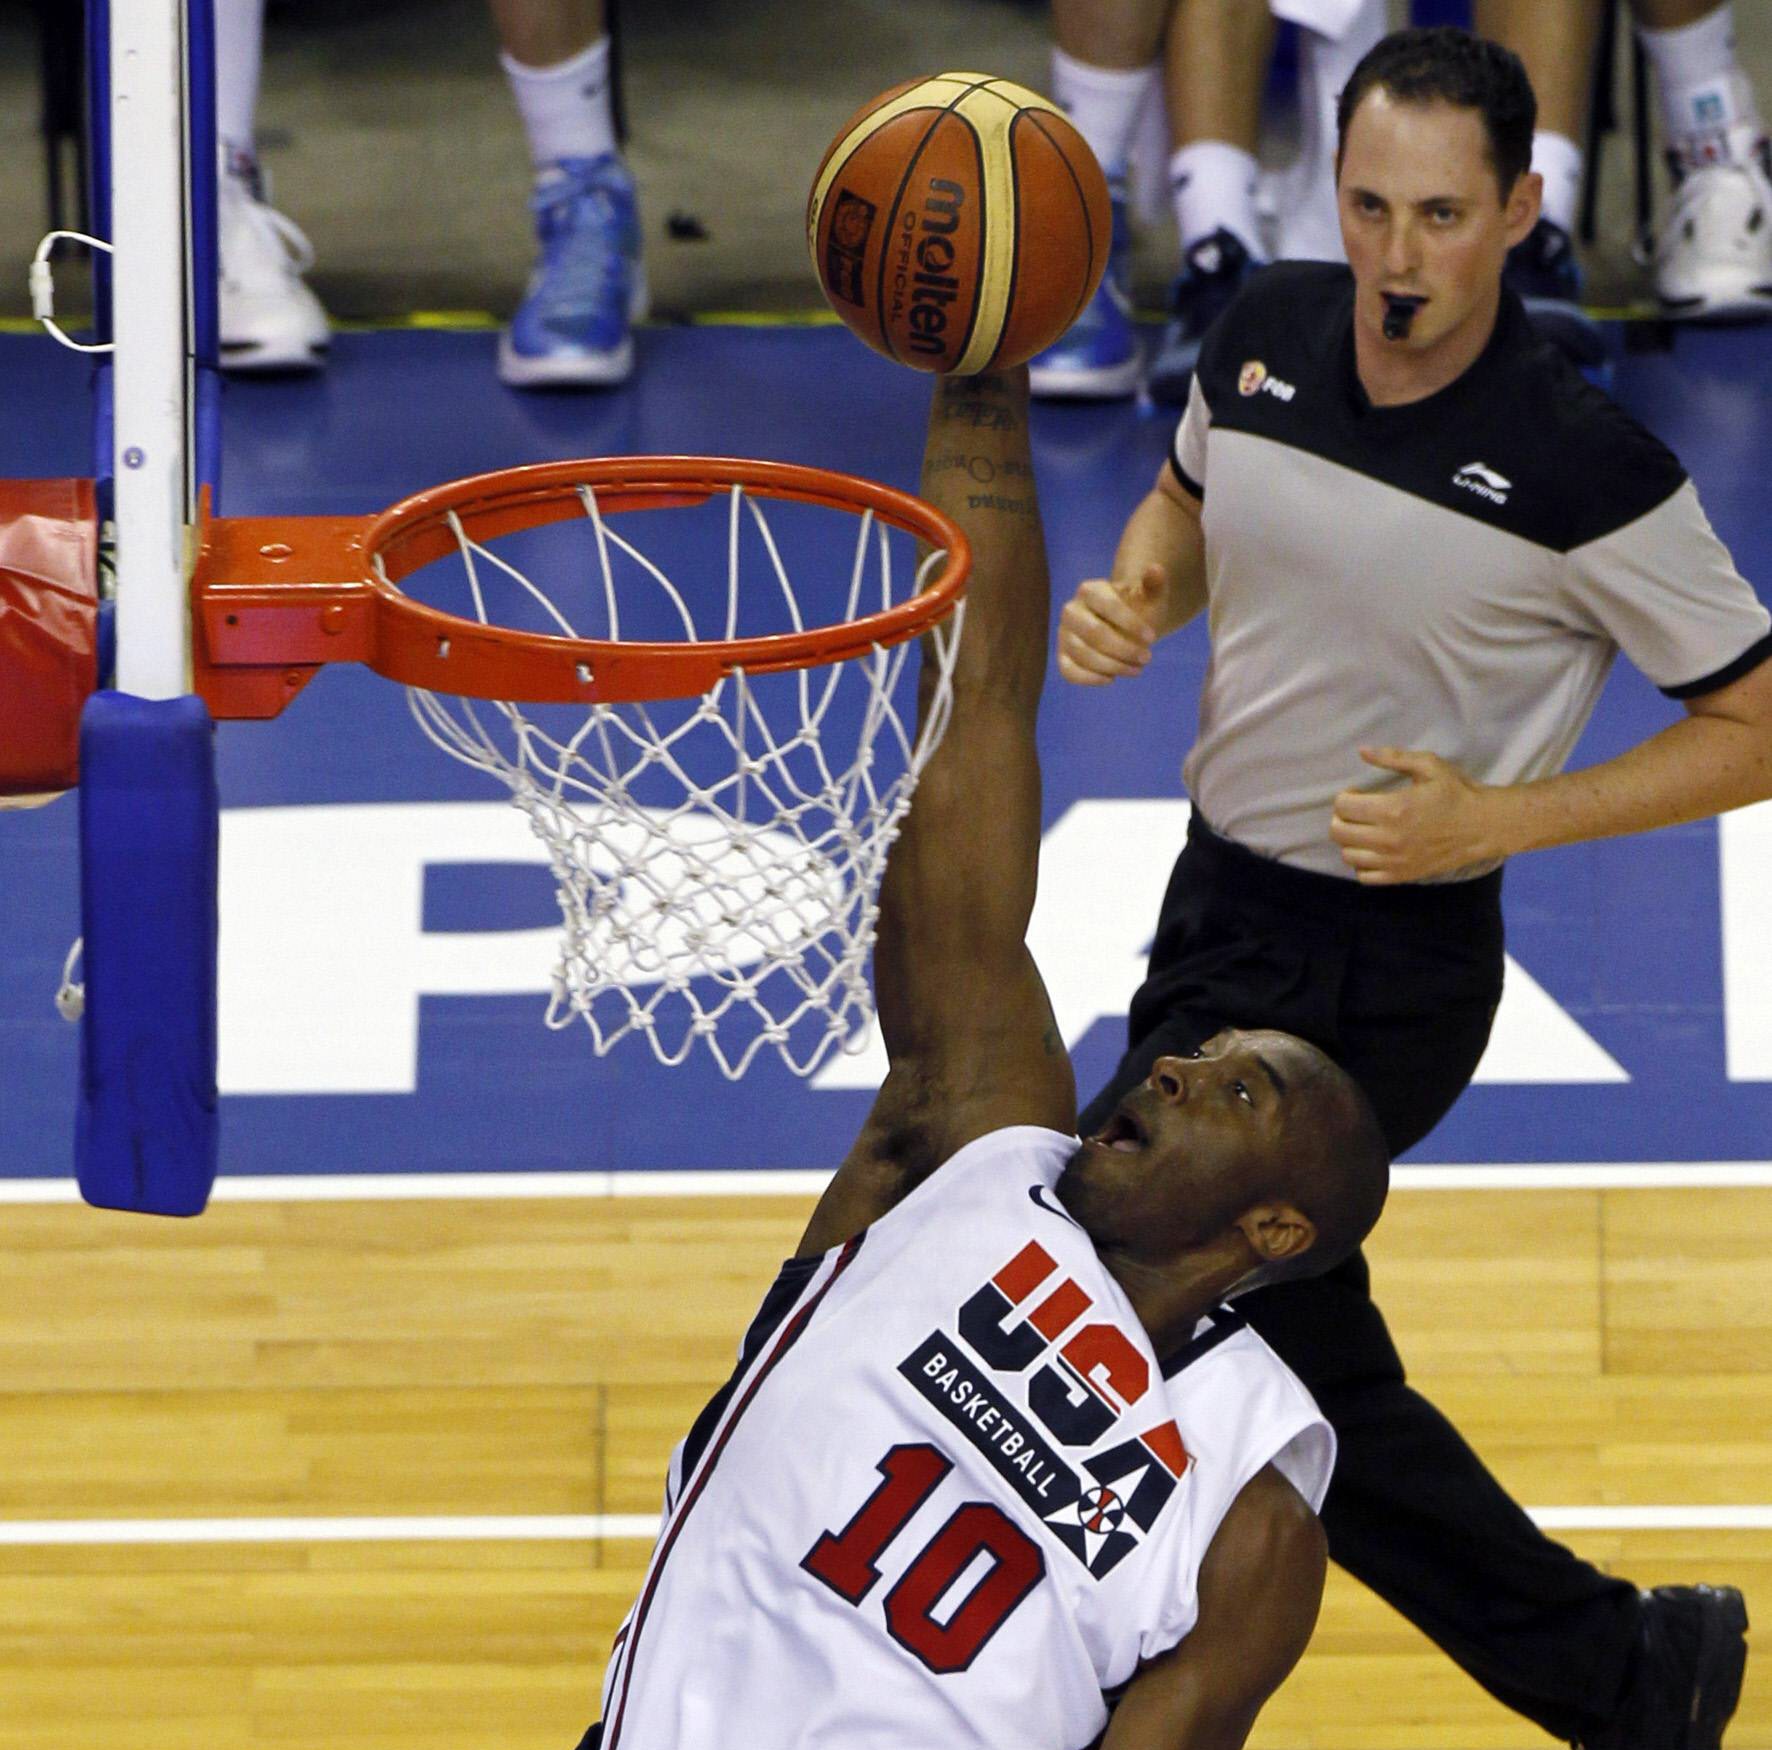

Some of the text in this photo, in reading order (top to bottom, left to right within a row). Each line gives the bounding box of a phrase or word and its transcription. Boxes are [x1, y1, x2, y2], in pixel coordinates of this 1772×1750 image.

[891, 211, 916, 322] OFFICIAL
[908, 177, 965, 355] molten
[922, 1351, 1057, 1498] BASKETBALL
[958, 1239, 1190, 1582] USA
[799, 1442, 1047, 1675] 10
